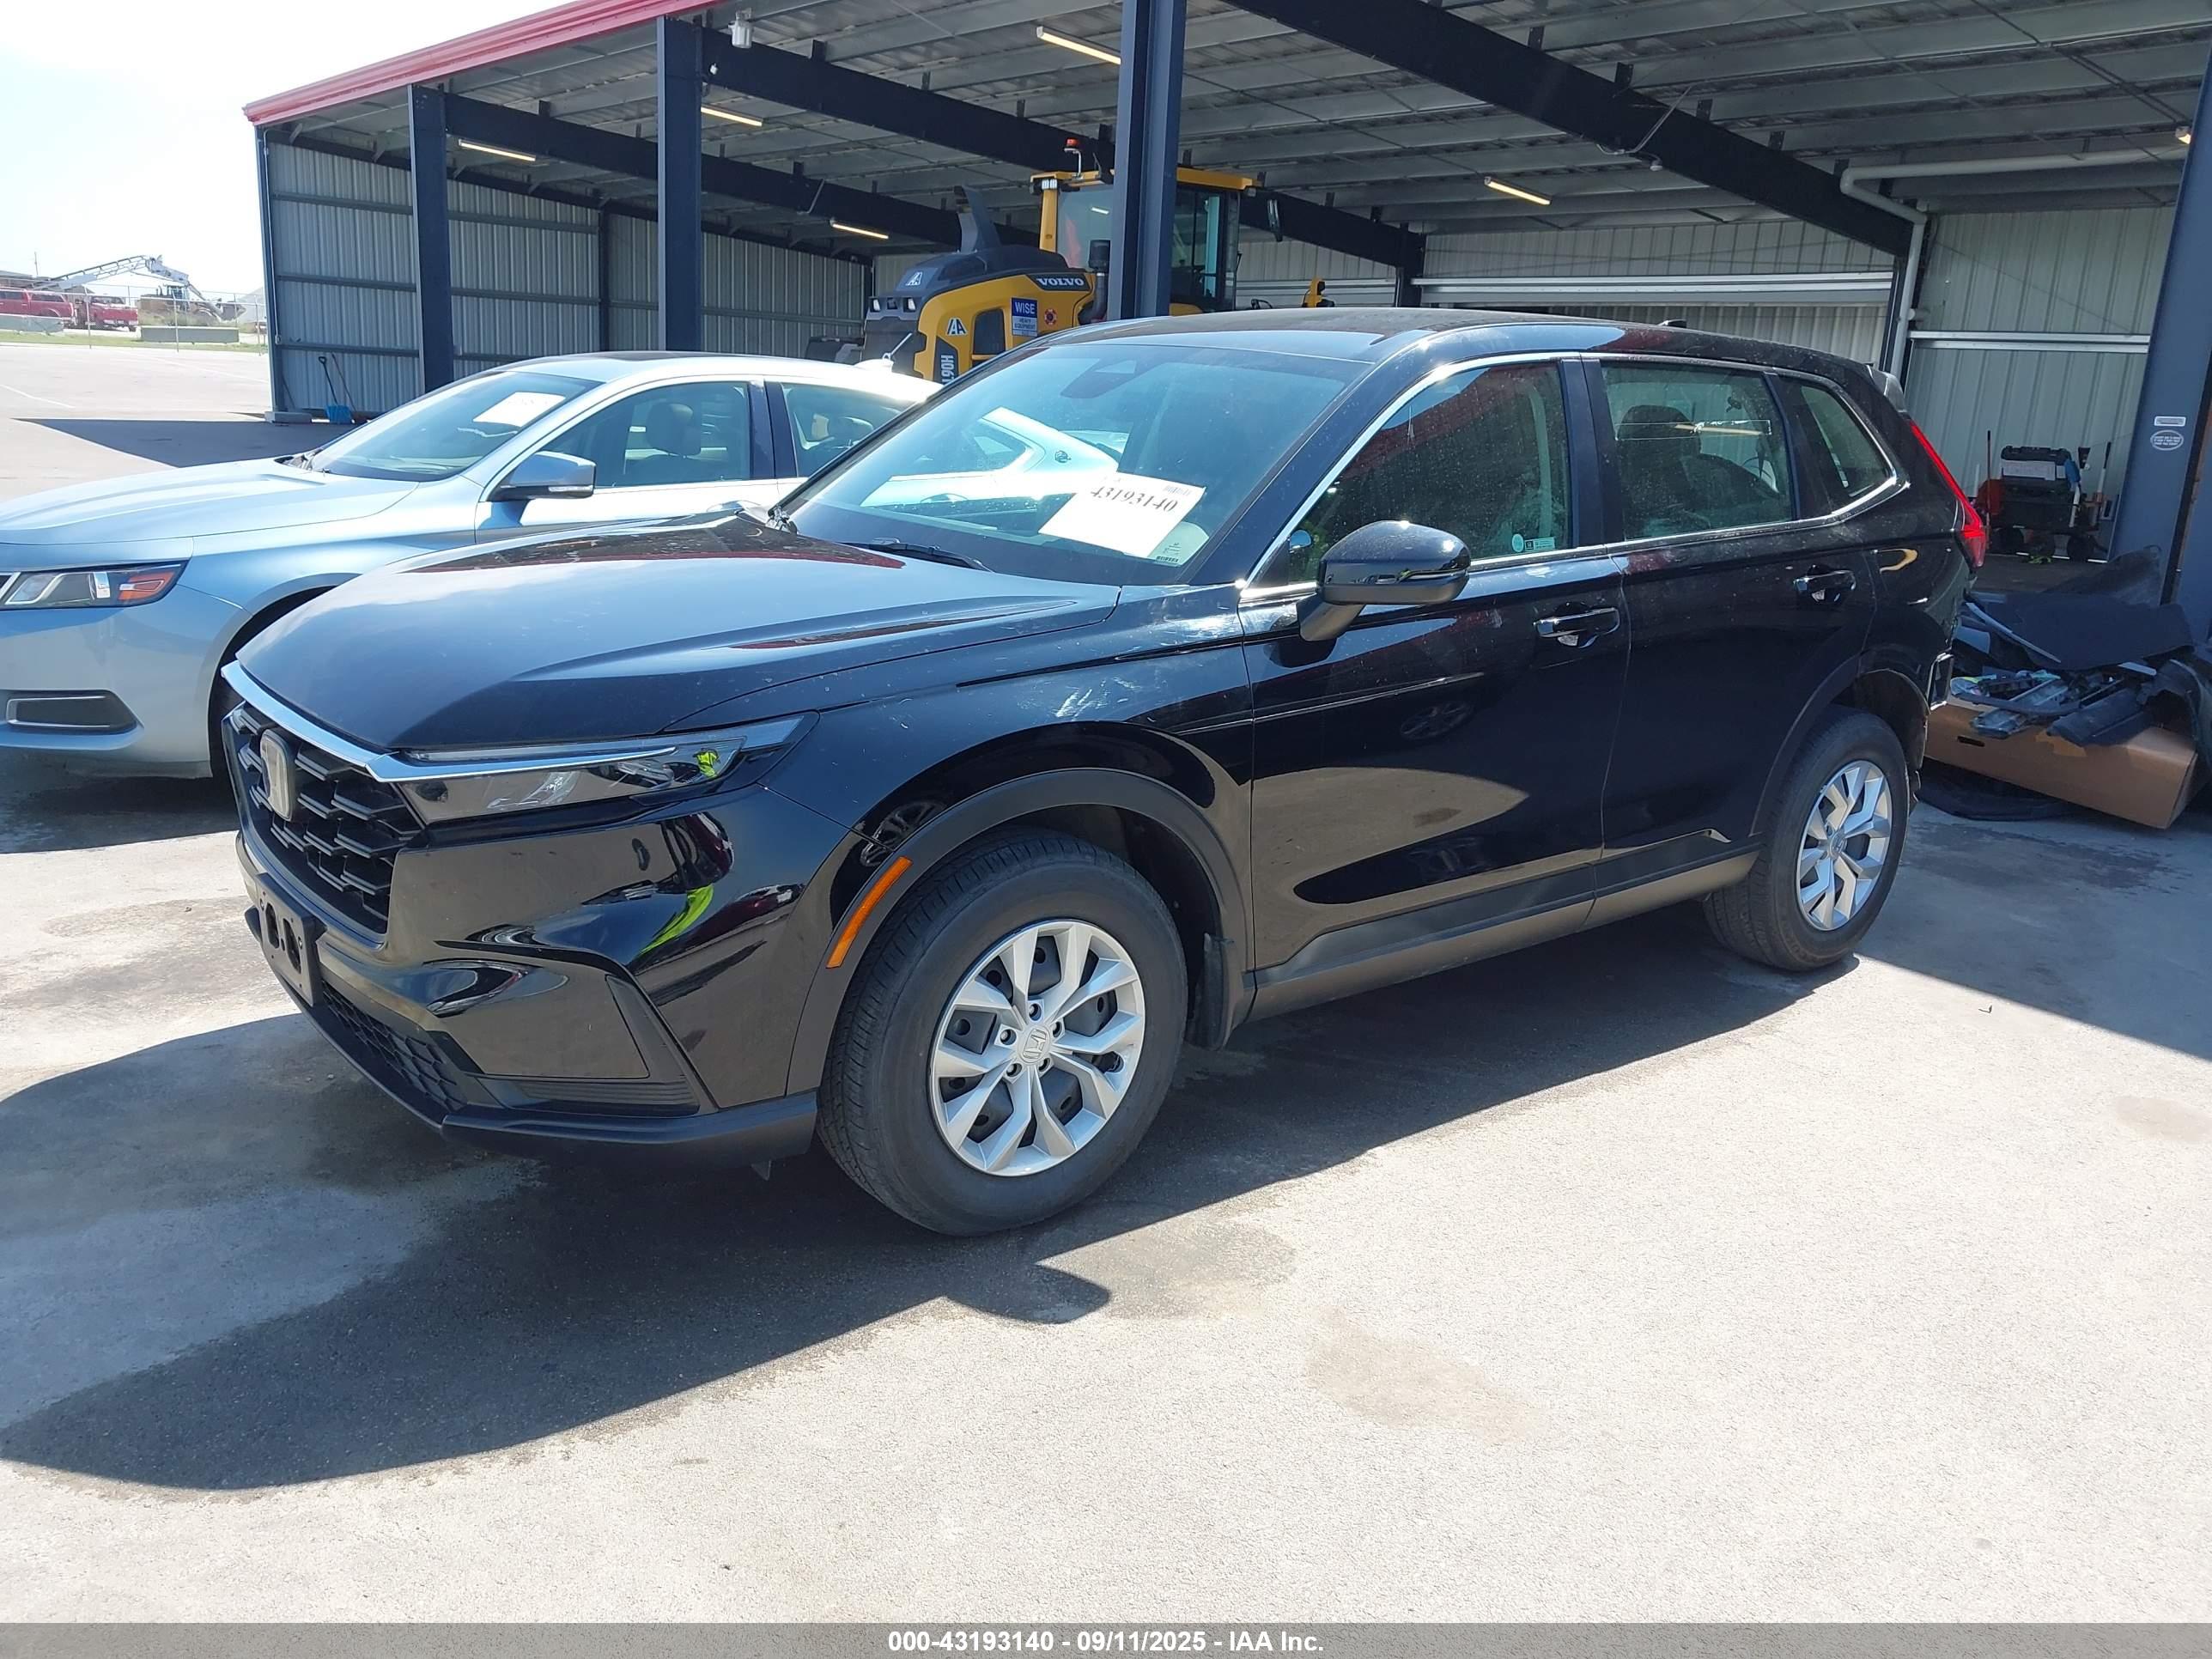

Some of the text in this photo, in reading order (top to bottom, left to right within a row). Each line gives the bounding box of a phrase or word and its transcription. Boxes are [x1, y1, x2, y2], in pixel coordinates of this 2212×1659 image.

[1036, 277, 1085, 286] VOLVO
[1014, 301, 1036, 314] WISE
[1090, 485, 1179, 513] 43193140
